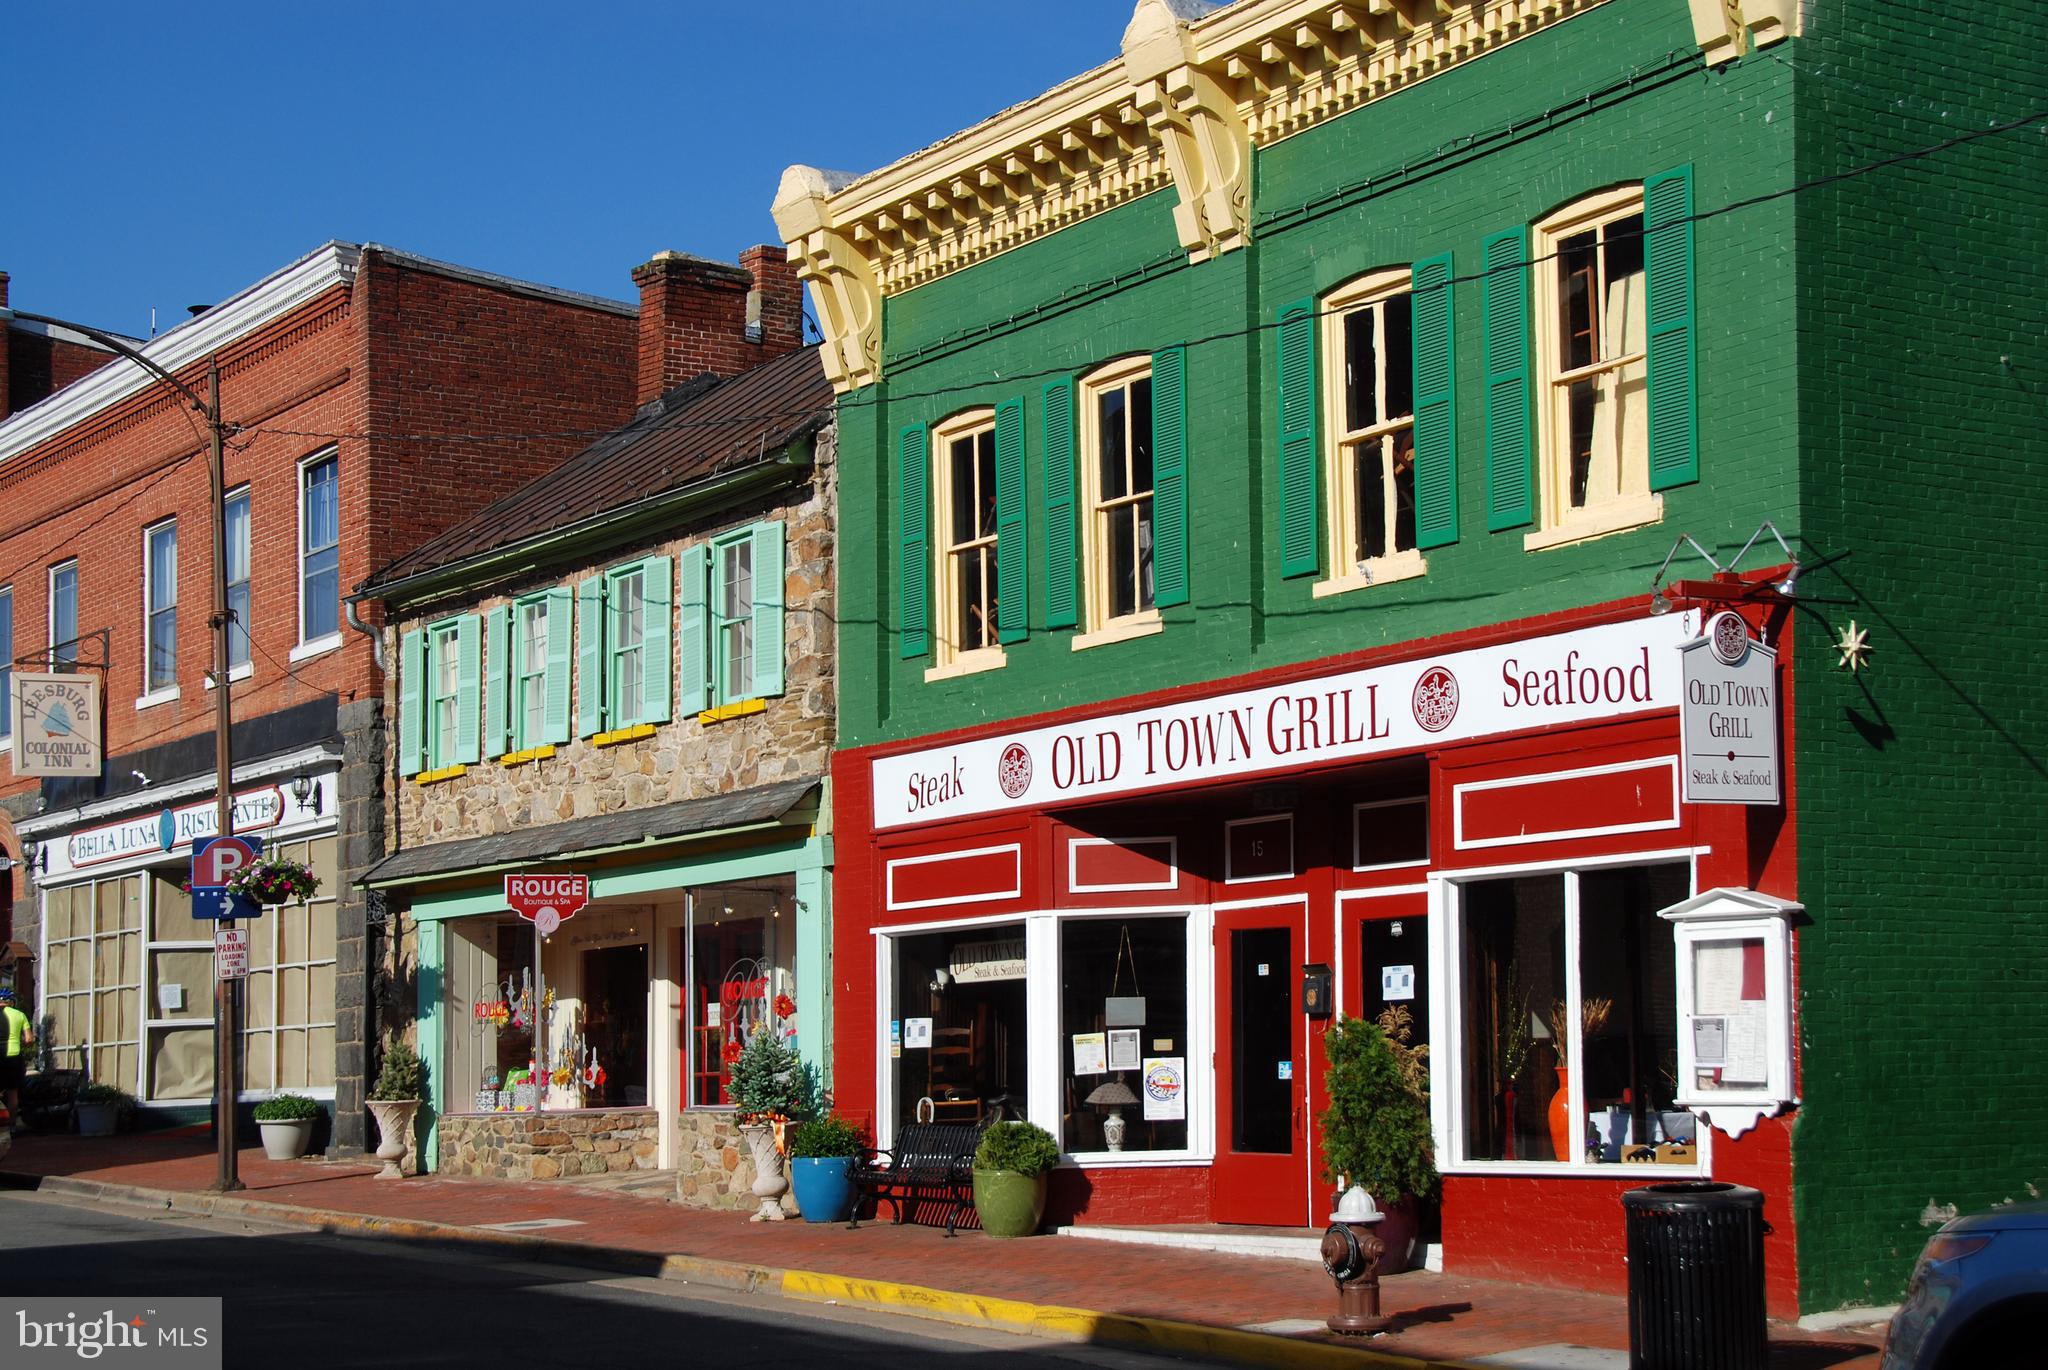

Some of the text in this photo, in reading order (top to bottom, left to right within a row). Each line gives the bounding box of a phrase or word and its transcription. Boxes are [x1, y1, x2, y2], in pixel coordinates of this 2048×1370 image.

[1689, 679, 1769, 707] OLD TOWN
[24, 684, 89, 721] LEESBURG
[908, 646, 1653, 813] Steak OLD TOWN GRILL Seafood
[1709, 712, 1752, 739] GRILL
[26, 741, 91, 755] COLONIAL
[44, 755, 73, 767] INN
[1692, 769, 1771, 786] Steak & Seafood
[78, 797, 269, 859] BELLA LUNA RISTANTE
[1251, 840, 1264, 857] 15
[213, 848, 243, 882] P
[511, 880, 583, 896] ROUGE
[226, 933, 238, 941] NO
[218, 943, 247, 953] PARKING
[953, 945, 976, 975] OLD
[974, 964, 991, 978] Steak
[1000, 961, 1027, 976] Seafood
[723, 977, 769, 1000] ROUGE
[474, 1001, 508, 1018] ROUGE
